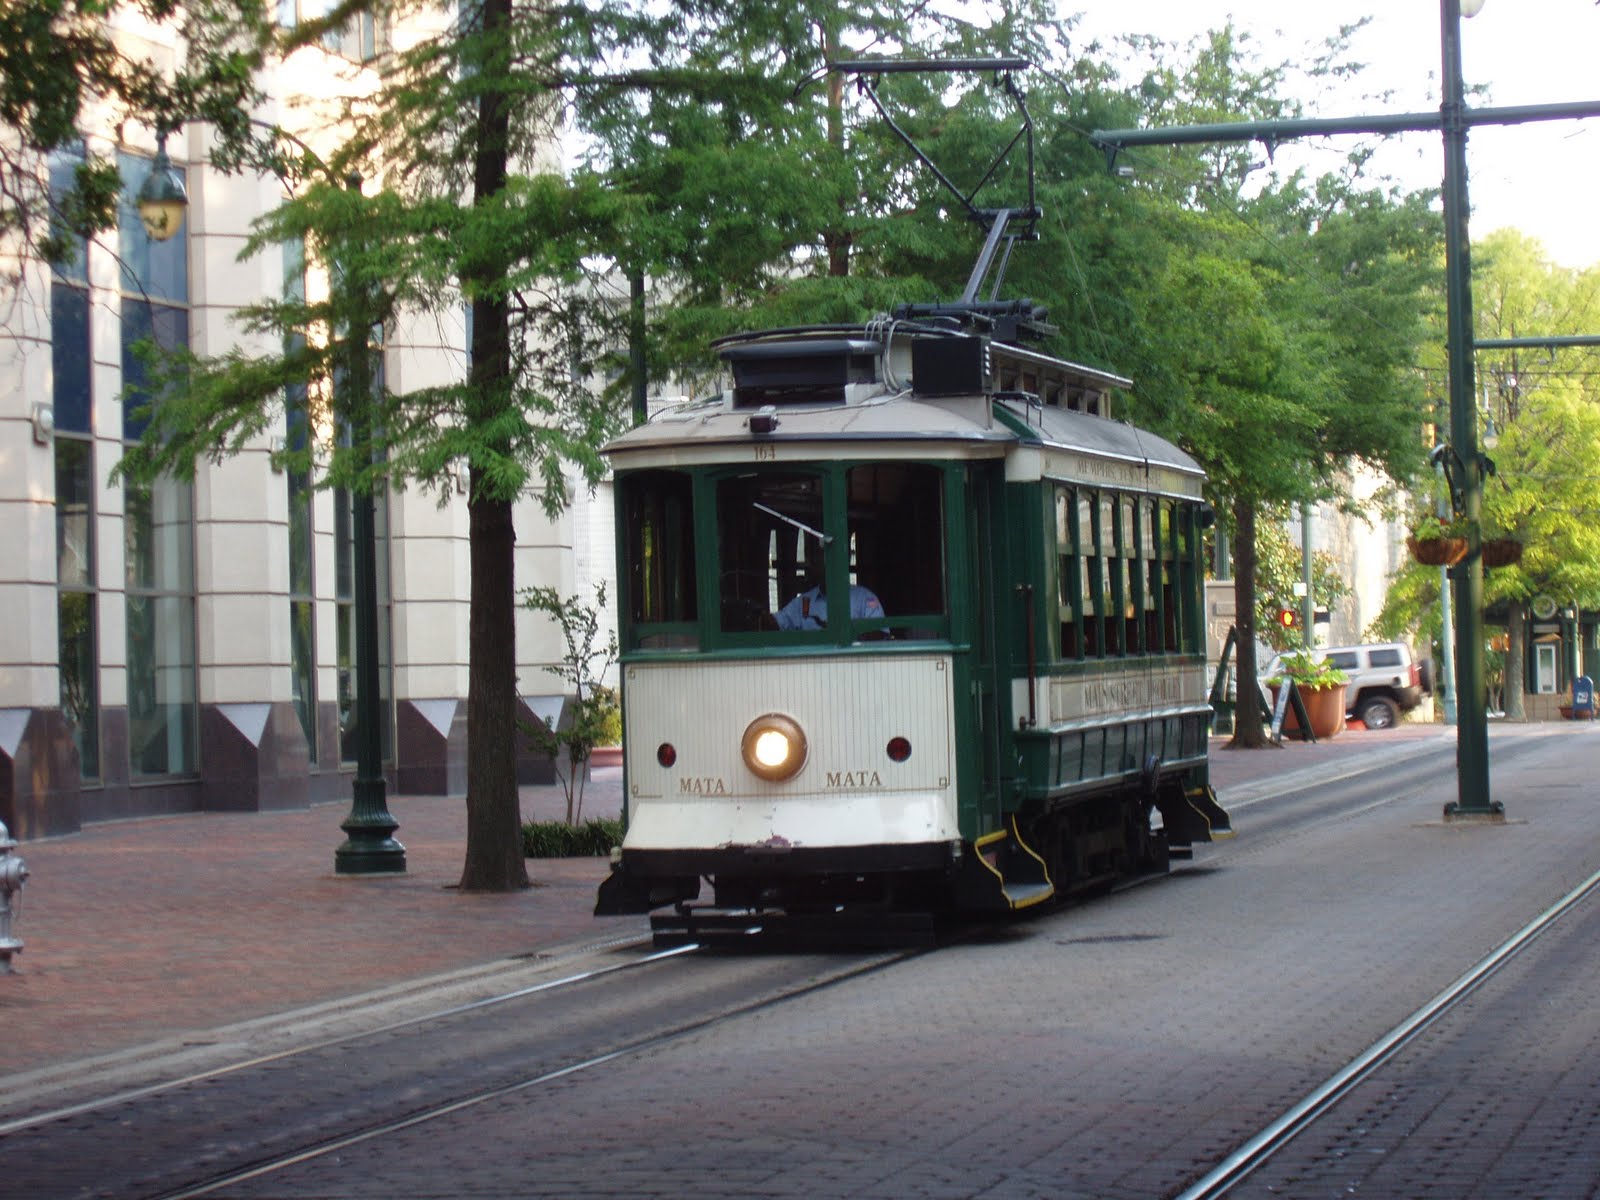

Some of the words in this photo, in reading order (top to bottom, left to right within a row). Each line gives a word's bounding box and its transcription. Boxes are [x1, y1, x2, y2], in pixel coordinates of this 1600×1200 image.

[754, 445, 776, 460] 164
[1084, 683, 1107, 709] MAIN
[680, 778, 725, 793] MATA
[826, 771, 882, 788] MATA
